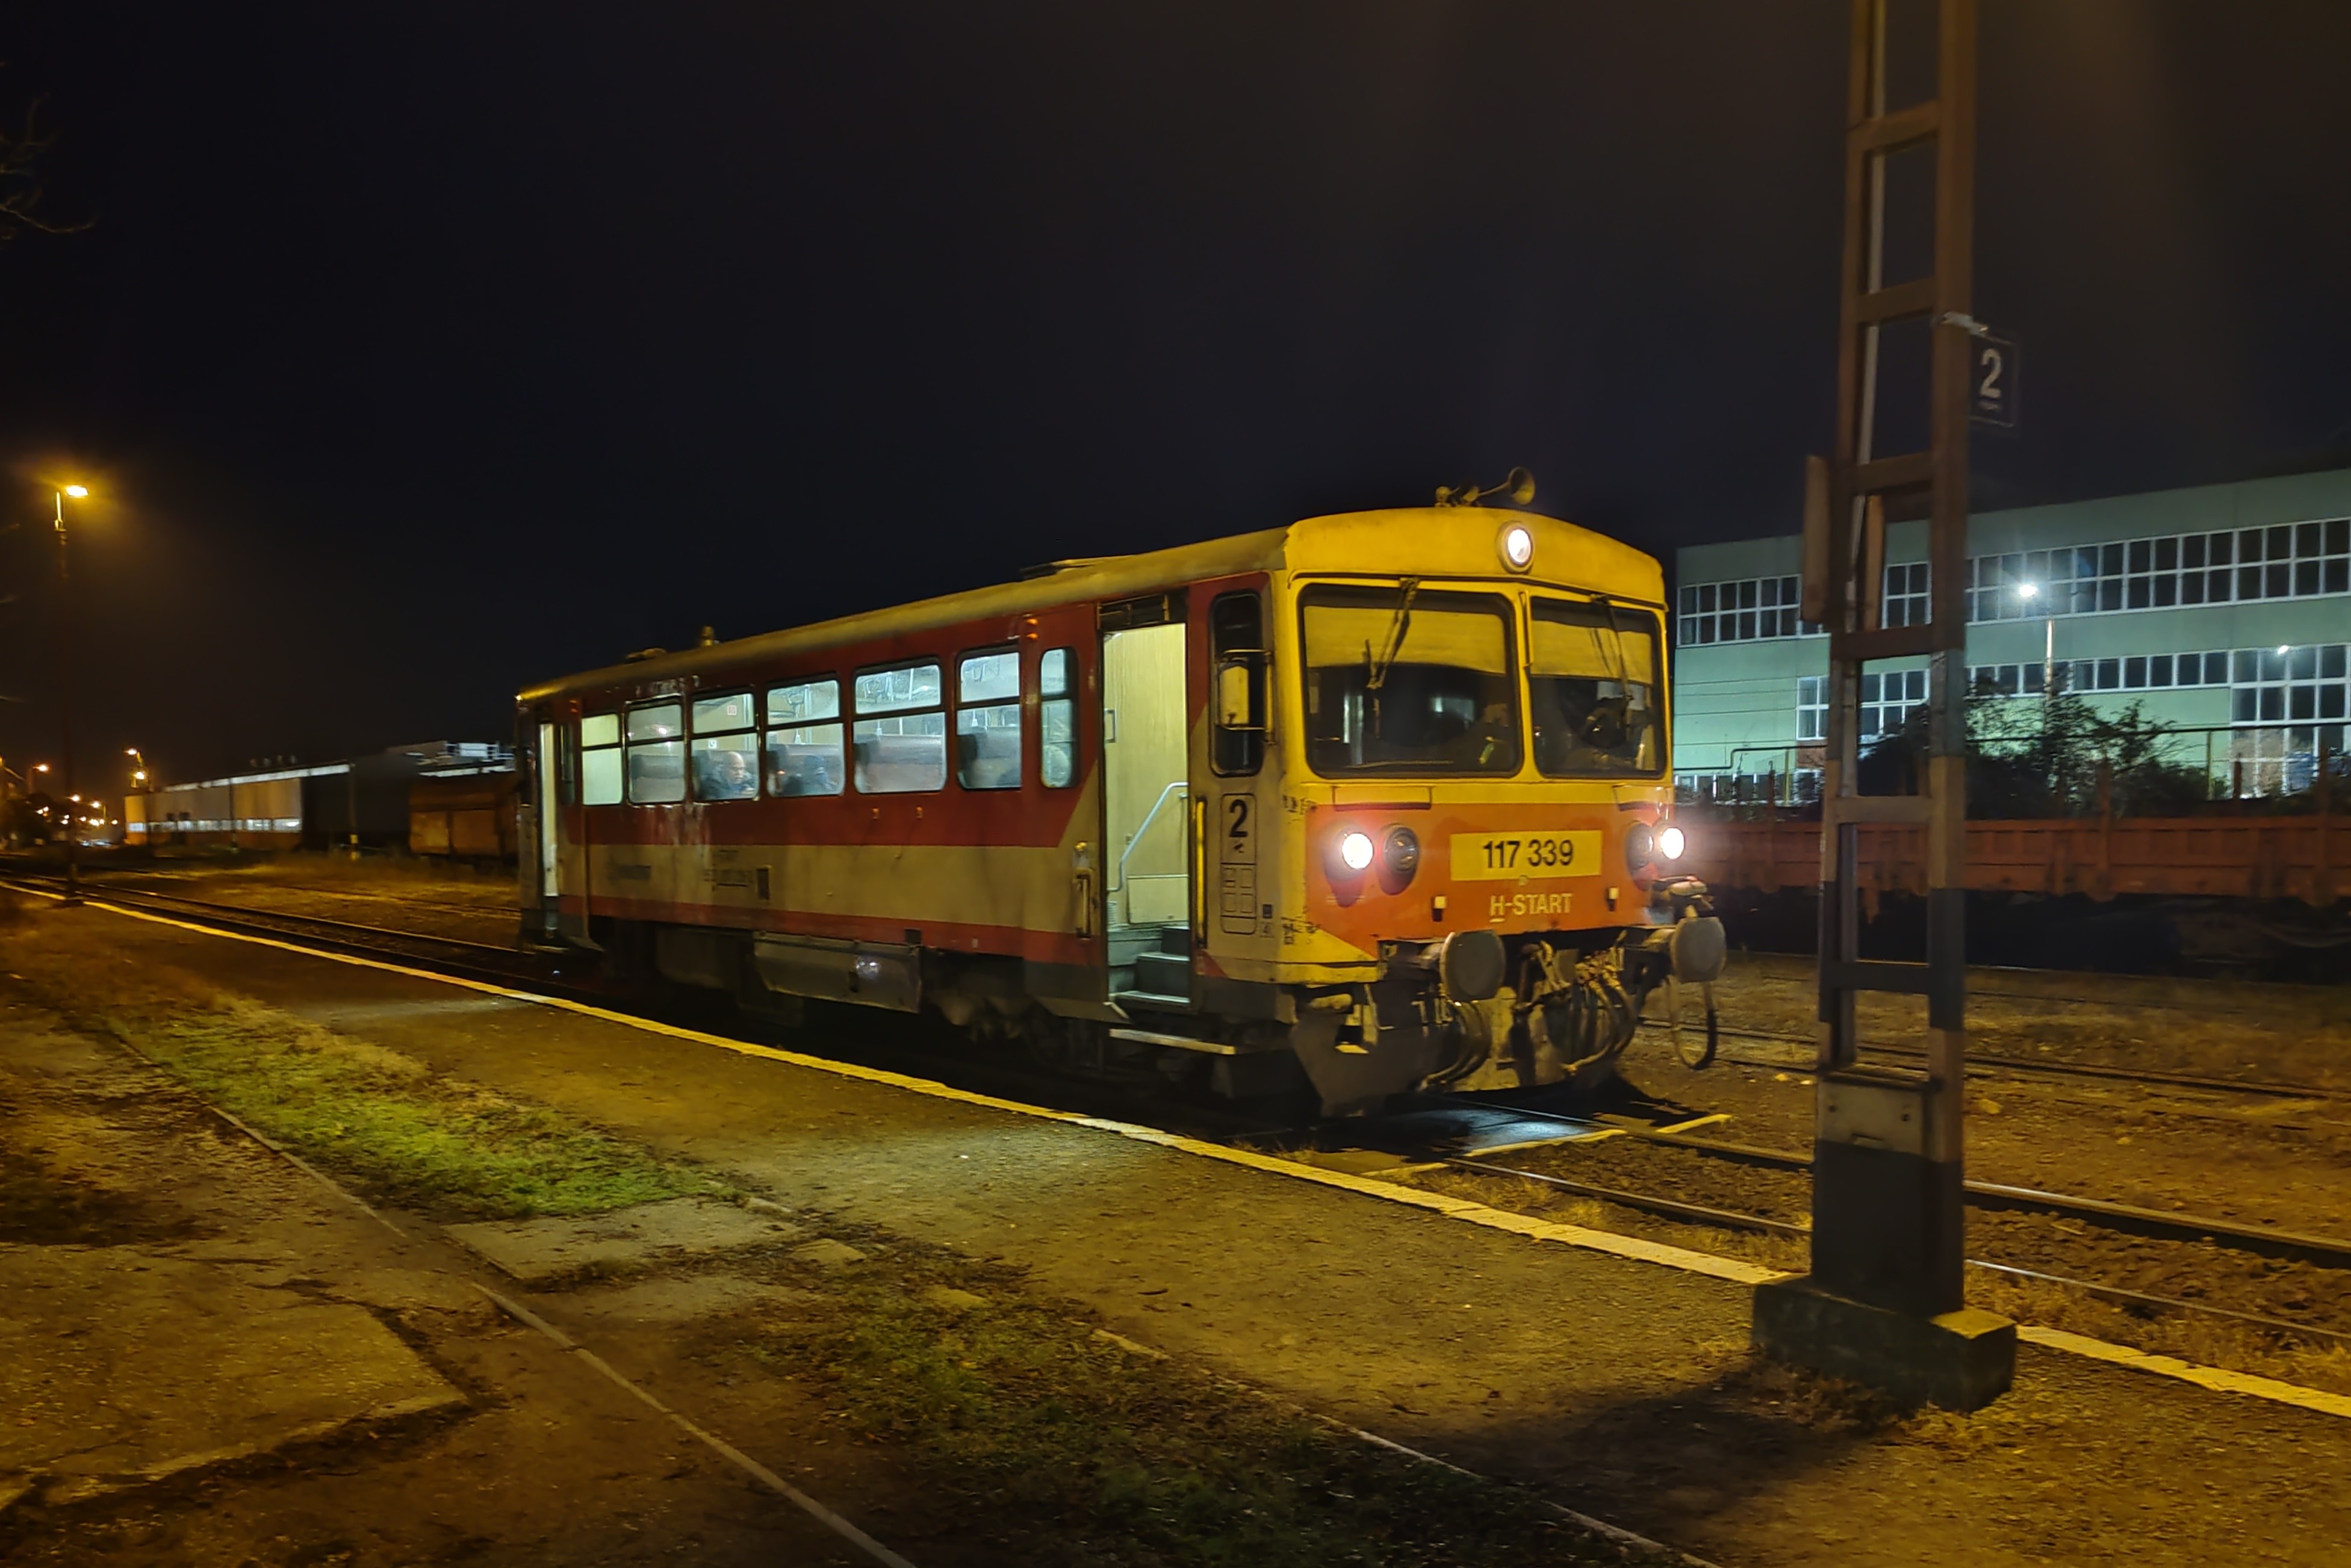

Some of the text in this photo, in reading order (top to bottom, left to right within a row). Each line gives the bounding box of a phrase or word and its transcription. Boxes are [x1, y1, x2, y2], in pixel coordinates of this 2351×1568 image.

[1980, 349, 2001, 398] 2
[1229, 799, 1247, 837] 2
[1483, 839, 1574, 868] 117 339
[1489, 892, 1573, 916] H-START
